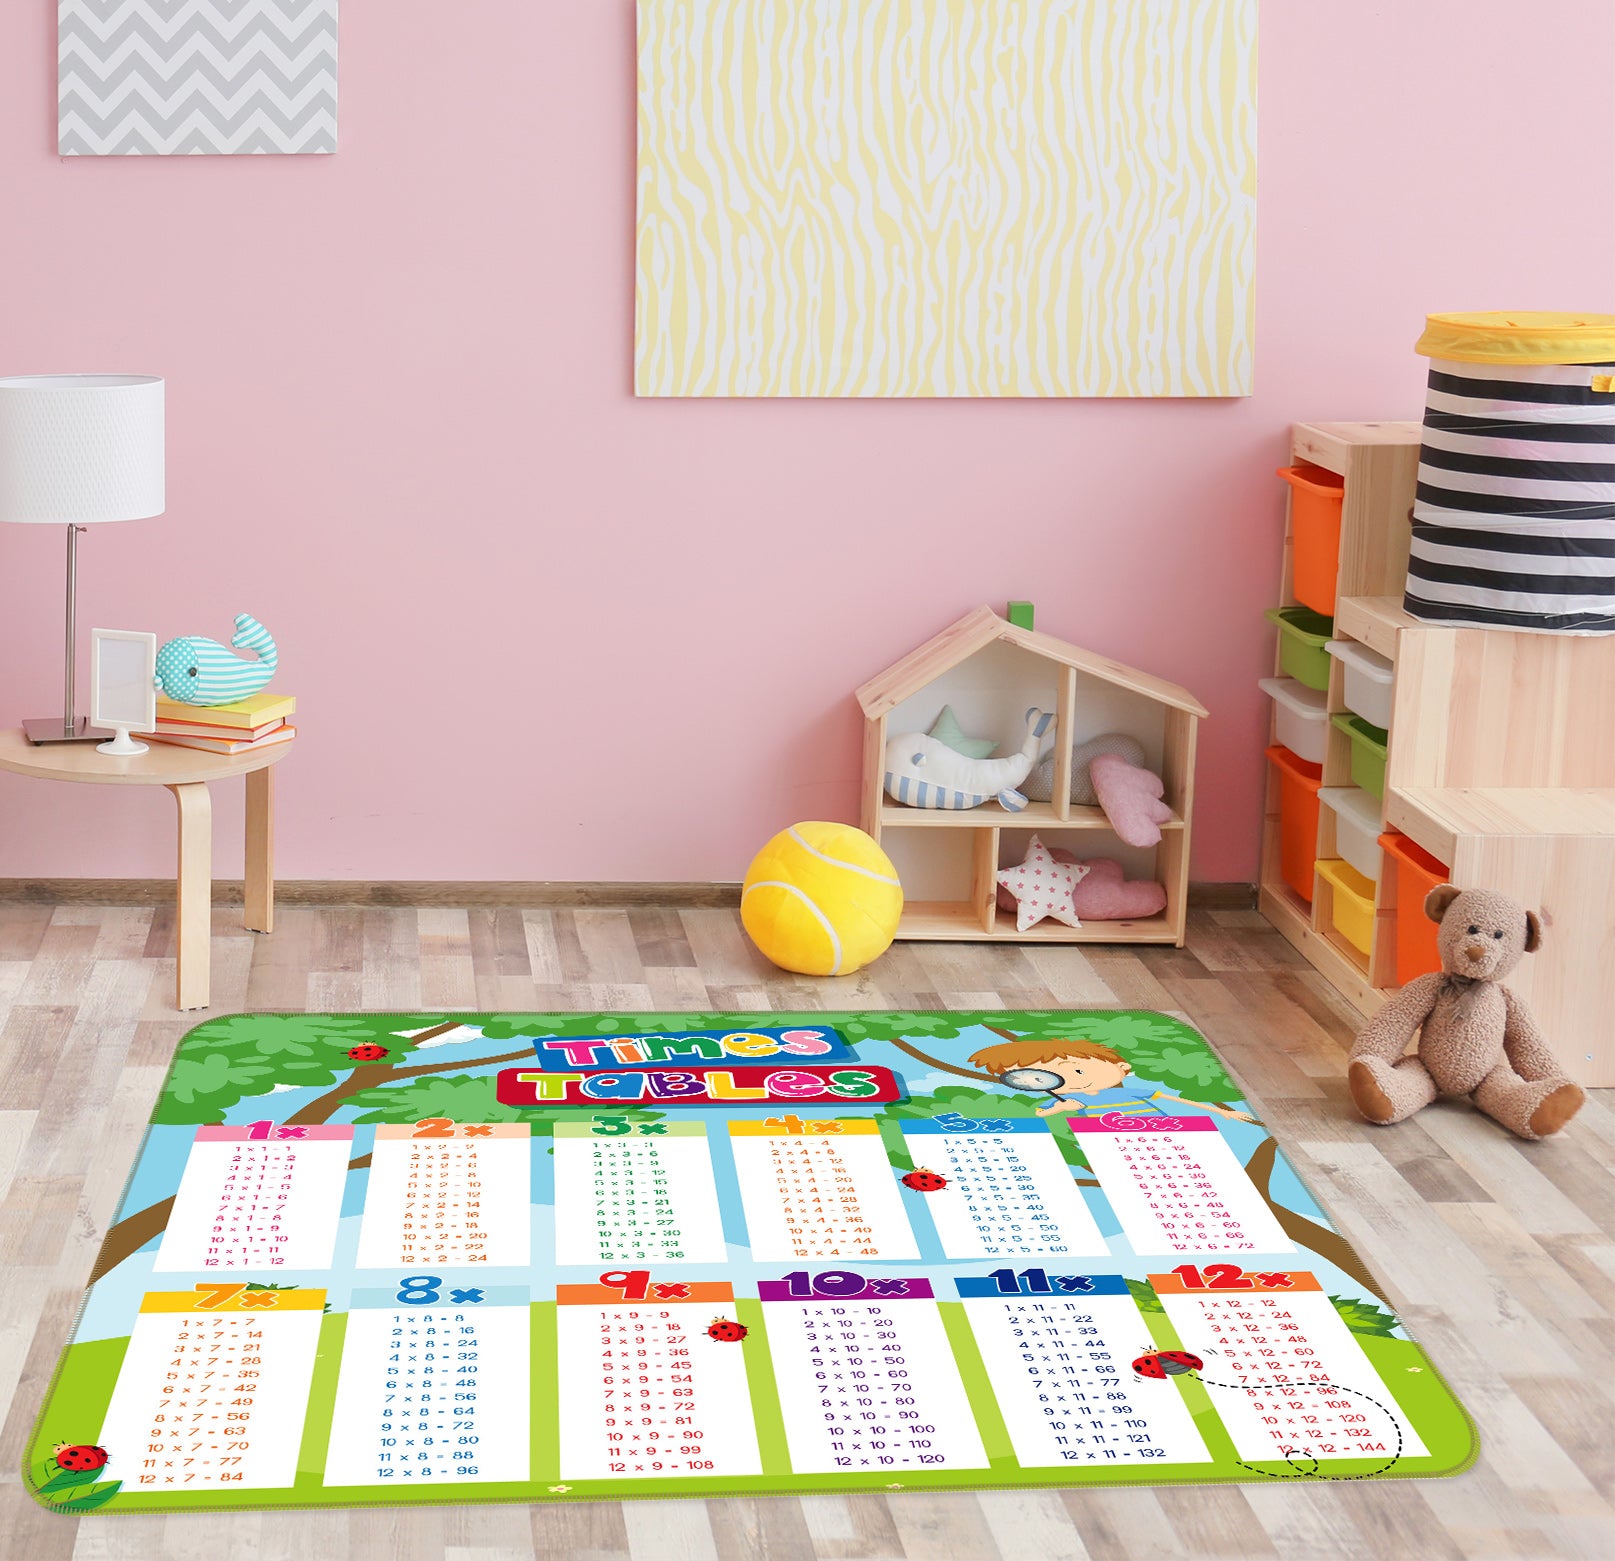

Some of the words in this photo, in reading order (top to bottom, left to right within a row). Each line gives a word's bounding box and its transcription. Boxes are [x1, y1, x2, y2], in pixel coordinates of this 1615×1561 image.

[218, 1204, 229, 1212] 7
[251, 1204, 257, 1212] 1
[436, 1201, 447, 1209] 2
[598, 1252, 615, 1260] 12
[636, 1251, 646, 1259] 3
[665, 1250, 685, 1259] 36
[793, 1248, 809, 1257] 12
[829, 1248, 841, 1256] 4
[859, 1247, 879, 1256] 48
[204, 1258, 220, 1266] 12
[242, 1257, 249, 1266] 1
[269, 1257, 285, 1265] 12
[399, 1255, 416, 1263] 12
[437, 1254, 448, 1263] 2
[467, 1253, 488, 1262] 24
[1008, 1316, 1020, 1325] 2
[1040, 1315, 1054, 1324] 11
[1072, 1314, 1094, 1323] 22
[1204, 1312, 1216, 1321] 2
[1235, 1311, 1254, 1320] 12
[1271, 1310, 1293, 1319] 24
[391, 1327, 403, 1336] 2
[426, 1327, 437, 1335] 8
[459, 1326, 475, 1335] 16
[601, 1336, 611, 1345] 3
[635, 1336, 645, 1345] 9
[666, 1335, 687, 1344] 27
[809, 1345, 821, 1353] 4
[844, 1344, 860, 1353] 10
[881, 1344, 902, 1352] 40
[1223, 1349, 1237, 1358] 5
[1257, 1348, 1276, 1357] 12
[1293, 1347, 1315, 1356] 60
[170, 1358, 182, 1367] 4
[207, 1357, 219, 1367] 7
[240, 1356, 262, 1366] 28
[388, 1353, 400, 1362] 4
[424, 1352, 435, 1362] 8
[457, 1351, 479, 1361] 32
[602, 1362, 614, 1372] 5
[638, 1361, 649, 1371] 9
[670, 1361, 692, 1370] 45
[1027, 1366, 1040, 1375] 6
[1061, 1365, 1076, 1375] 11
[1094, 1365, 1116, 1374] 66
[817, 1384, 829, 1394] 7
[852, 1384, 870, 1393] 10
[890, 1383, 912, 1392] 70
[1253, 1402, 1265, 1411] 9
[1286, 1401, 1305, 1410] 12
[1323, 1400, 1352, 1409] 108
[153, 1413, 166, 1423] 8
[191, 1413, 205, 1422] 7
[226, 1411, 251, 1421] 56
[382, 1408, 394, 1418] 8
[419, 1407, 430, 1417] 8
[453, 1406, 476, 1416] 64
[826, 1426, 845, 1436] 10
[869, 1425, 887, 1435] 10
[907, 1424, 936, 1434] 100
[1048, 1421, 1066, 1431] 10
[1089, 1420, 1104, 1430] 11
[1123, 1419, 1148, 1429] 110
[606, 1432, 624, 1442] 10
[648, 1431, 660, 1441] 9
[682, 1430, 704, 1440] 90
[1268, 1430, 1284, 1440] 11
[1304, 1429, 1324, 1439] 12
[1343, 1427, 1373, 1438] 132
[380, 1437, 397, 1447] 10
[423, 1436, 435, 1446] 8
[457, 1435, 480, 1445] 80
[147, 1443, 165, 1453] 10
[191, 1442, 203, 1452] 7
[226, 1441, 250, 1451] 70
[833, 1456, 853, 1466] 12
[876, 1455, 895, 1465] 10
[916, 1453, 946, 1464] 120
[1059, 1450, 1079, 1460] 12
[1102, 1449, 1117, 1459] 11
[1136, 1448, 1167, 1458] 132
[608, 1462, 626, 1472] 12
[651, 1461, 664, 1471] 9
[686, 1460, 715, 1470] 108
[138, 1474, 157, 1484] 12
[183, 1473, 196, 1483] 7
[219, 1471, 244, 1482] 84
